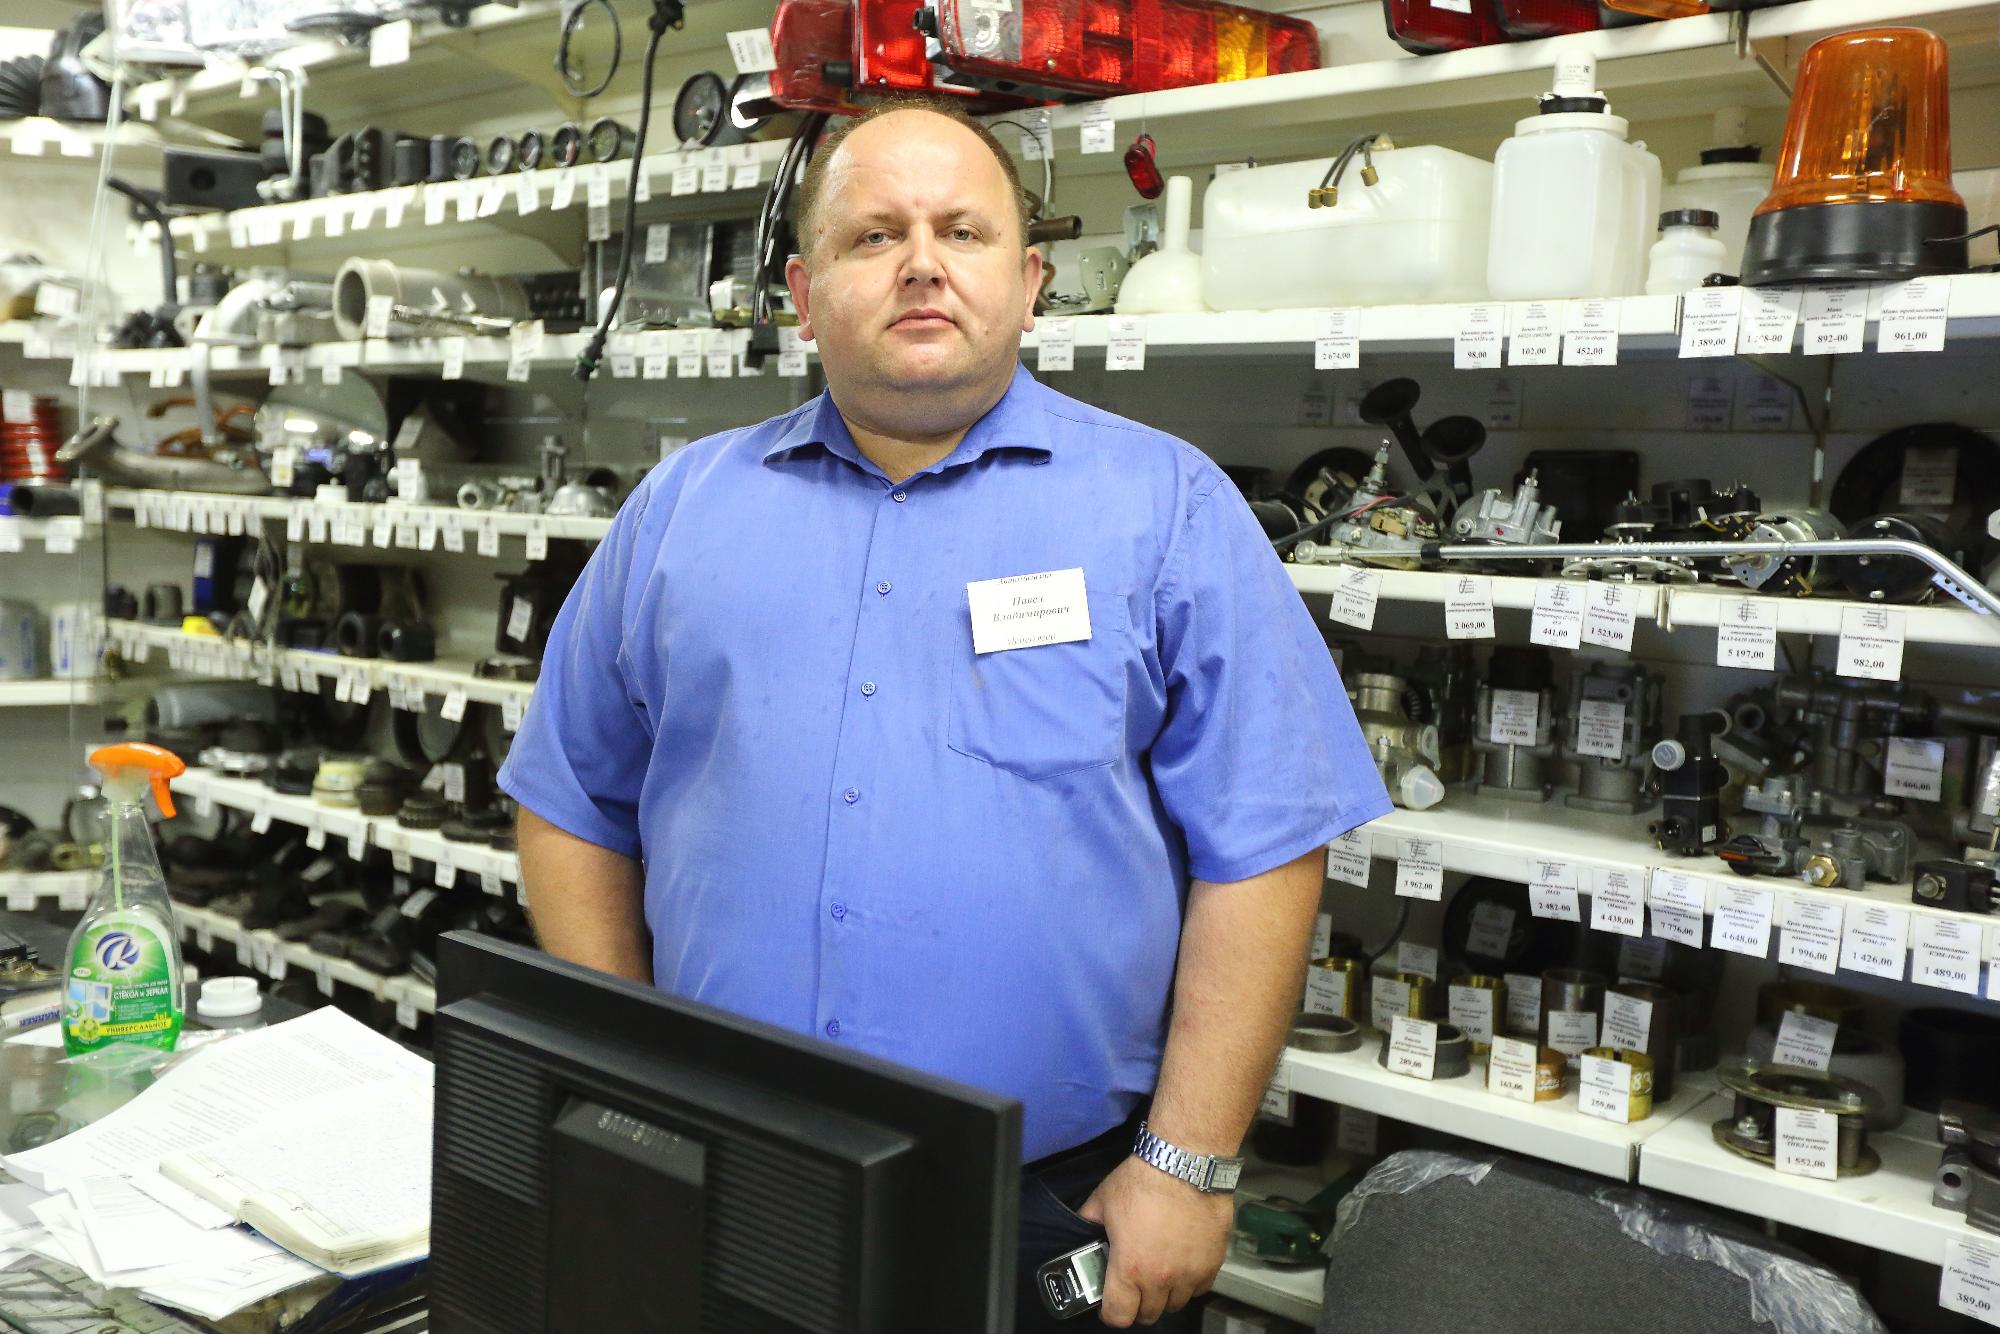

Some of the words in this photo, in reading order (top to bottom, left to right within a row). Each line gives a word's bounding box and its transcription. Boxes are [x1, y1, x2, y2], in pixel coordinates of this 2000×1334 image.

[1817, 334, 1849, 343] 892-00
[1894, 331, 1929, 341] 961,00
[1697, 338, 1726, 348] 389,00
[1467, 351, 1487, 360] 98,00
[1521, 347, 1547, 356] 102,00
[1576, 346, 1603, 356] 452,00
[1012, 594, 1044, 608] Павел
[992, 605, 1070, 623] Владимирович
[1461, 621, 1486, 630] 069,00
[1542, 627, 1568, 638] 441,00
[1597, 628, 1624, 640] 523,00
[1736, 649, 1764, 659] 197,00
[1853, 658, 1885, 669] 982,00
[1546, 903, 1571, 913] 482-00
[1607, 914, 1634, 926] 438,00
[1667, 922, 1694, 937] 776,00
[1729, 932, 1758, 946] 648,00
[1798, 948, 1828, 961] 996,00
[1860, 953, 1893, 968] 426,00
[1932, 968, 1967, 982] 489,00
[113, 990, 139, 1000] СТЕКОЛ
[145, 985, 169, 997] ЗЕРКАЛ
[105, 1021, 168, 1034] УНИВЕРСАЛЬНОЕ
[1794, 1157, 1826, 1169] 552,00
[1066, 1267, 1083, 1299] Panasonic
[1956, 1292, 1991, 1312] 389,00
